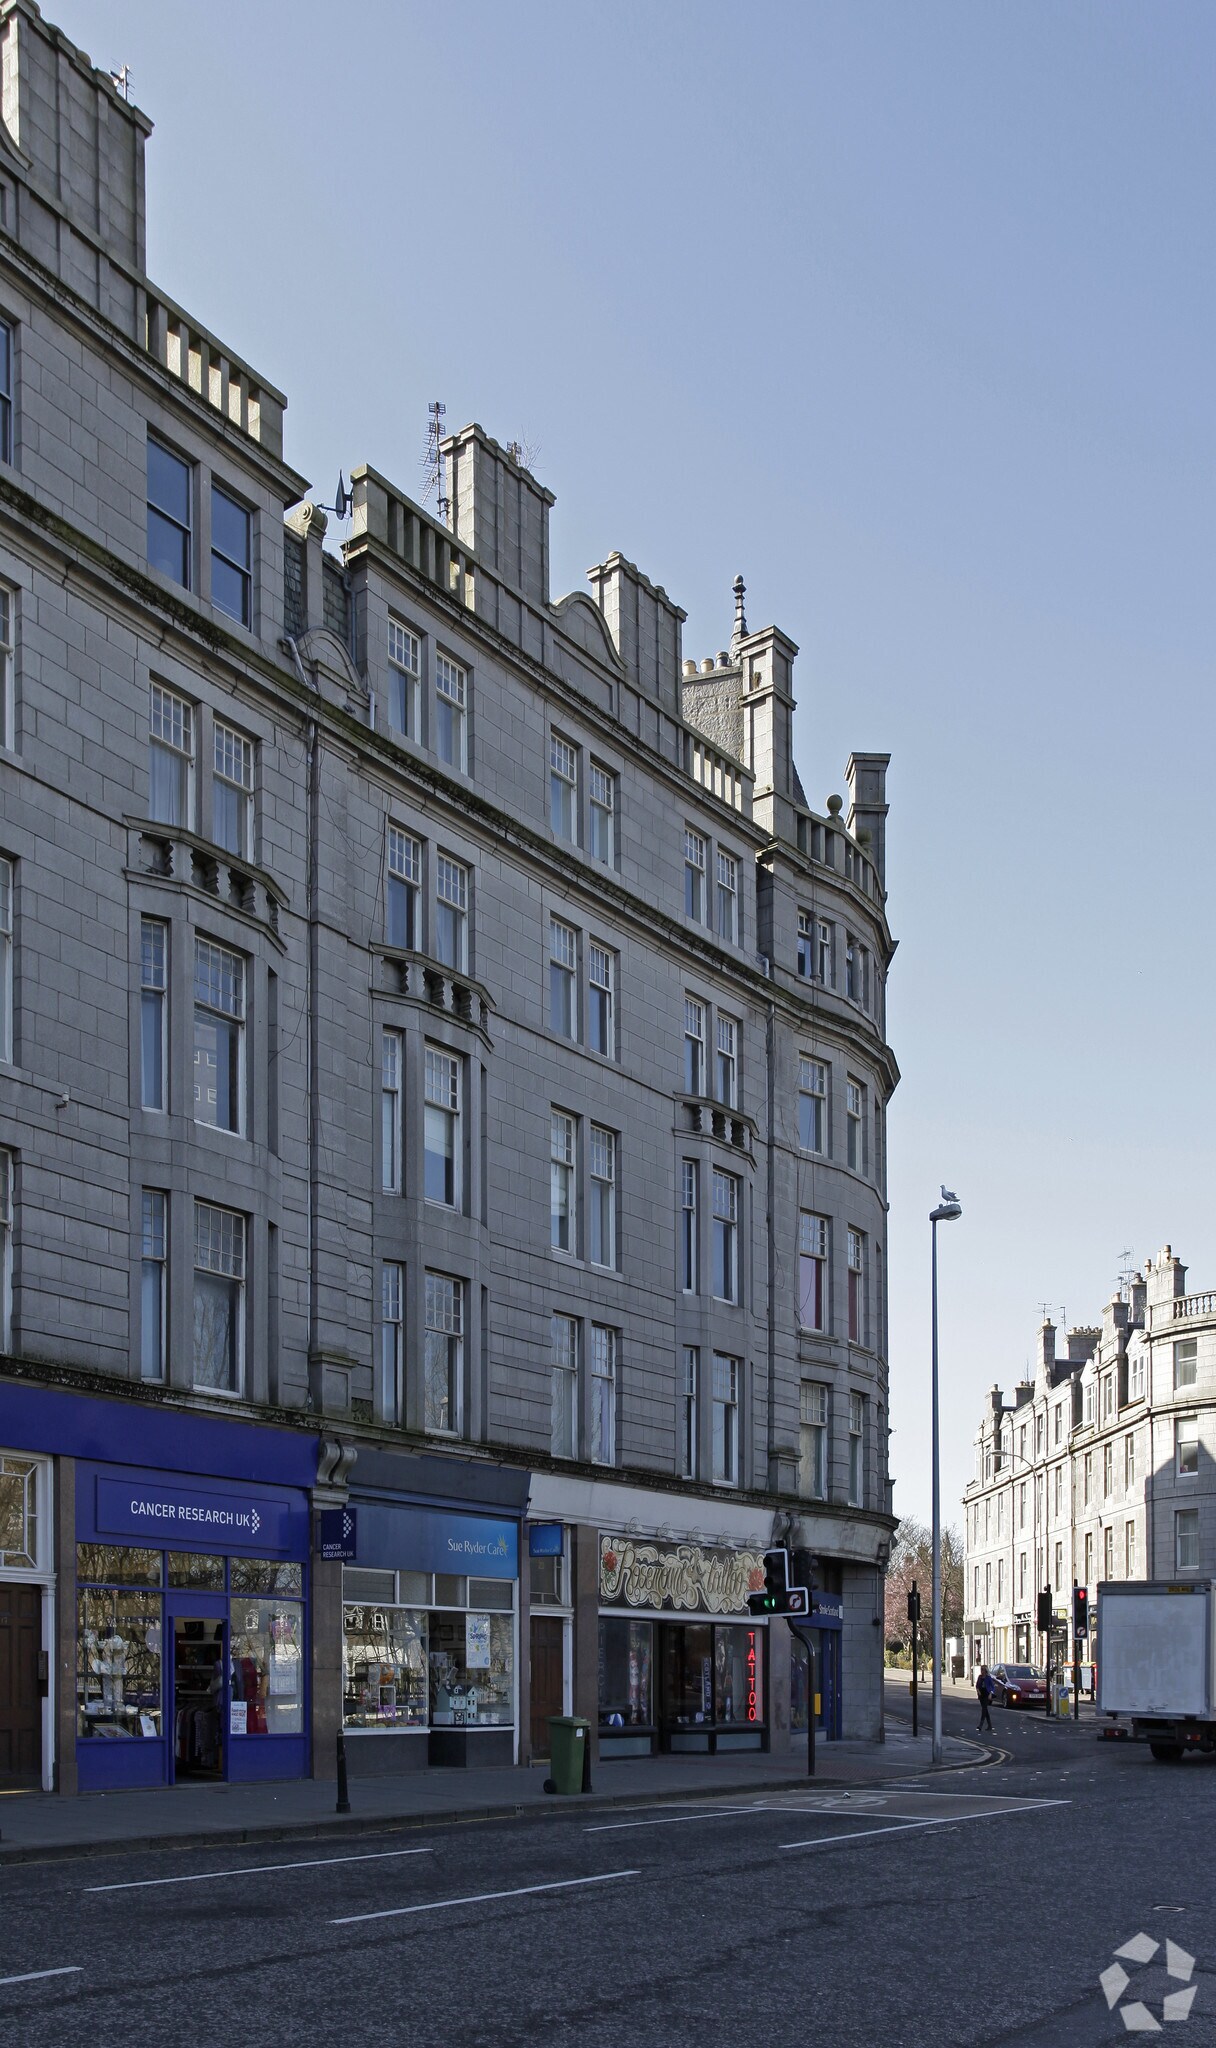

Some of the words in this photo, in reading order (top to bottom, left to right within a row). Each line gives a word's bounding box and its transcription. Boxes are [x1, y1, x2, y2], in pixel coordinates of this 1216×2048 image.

[130, 1500, 176, 1519] CANCER
[178, 1506, 234, 1526] RESEARCH
[235, 1513, 250, 1528] UK
[322, 1543, 342, 1551] CANCER
[447, 1538, 463, 1552] Sue
[464, 1540, 487, 1555] Ryder
[487, 1542, 504, 1556] Care
[747, 1631, 757, 1722] TATTOO
